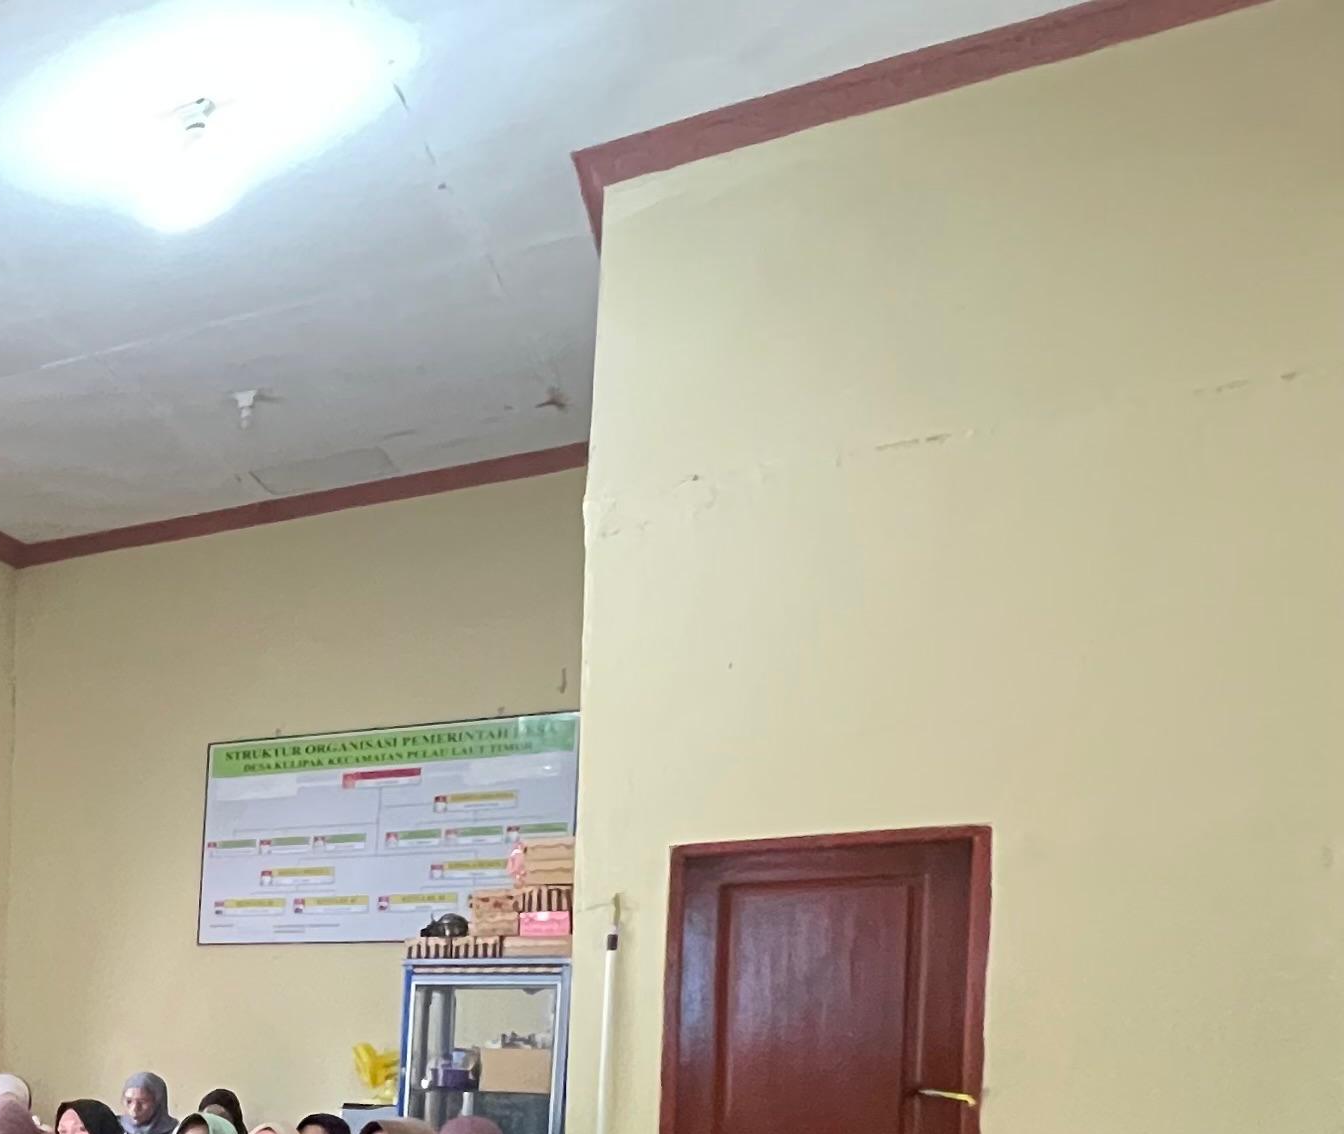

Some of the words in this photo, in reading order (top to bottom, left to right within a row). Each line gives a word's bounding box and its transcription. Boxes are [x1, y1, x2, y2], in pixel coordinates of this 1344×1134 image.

[225, 745, 301, 761] STRUKTUR
[305, 737, 398, 755] ORGANISASI
[402, 728, 509, 747] PEMERINTAH
[328, 752, 403, 766] KECAMATAN
